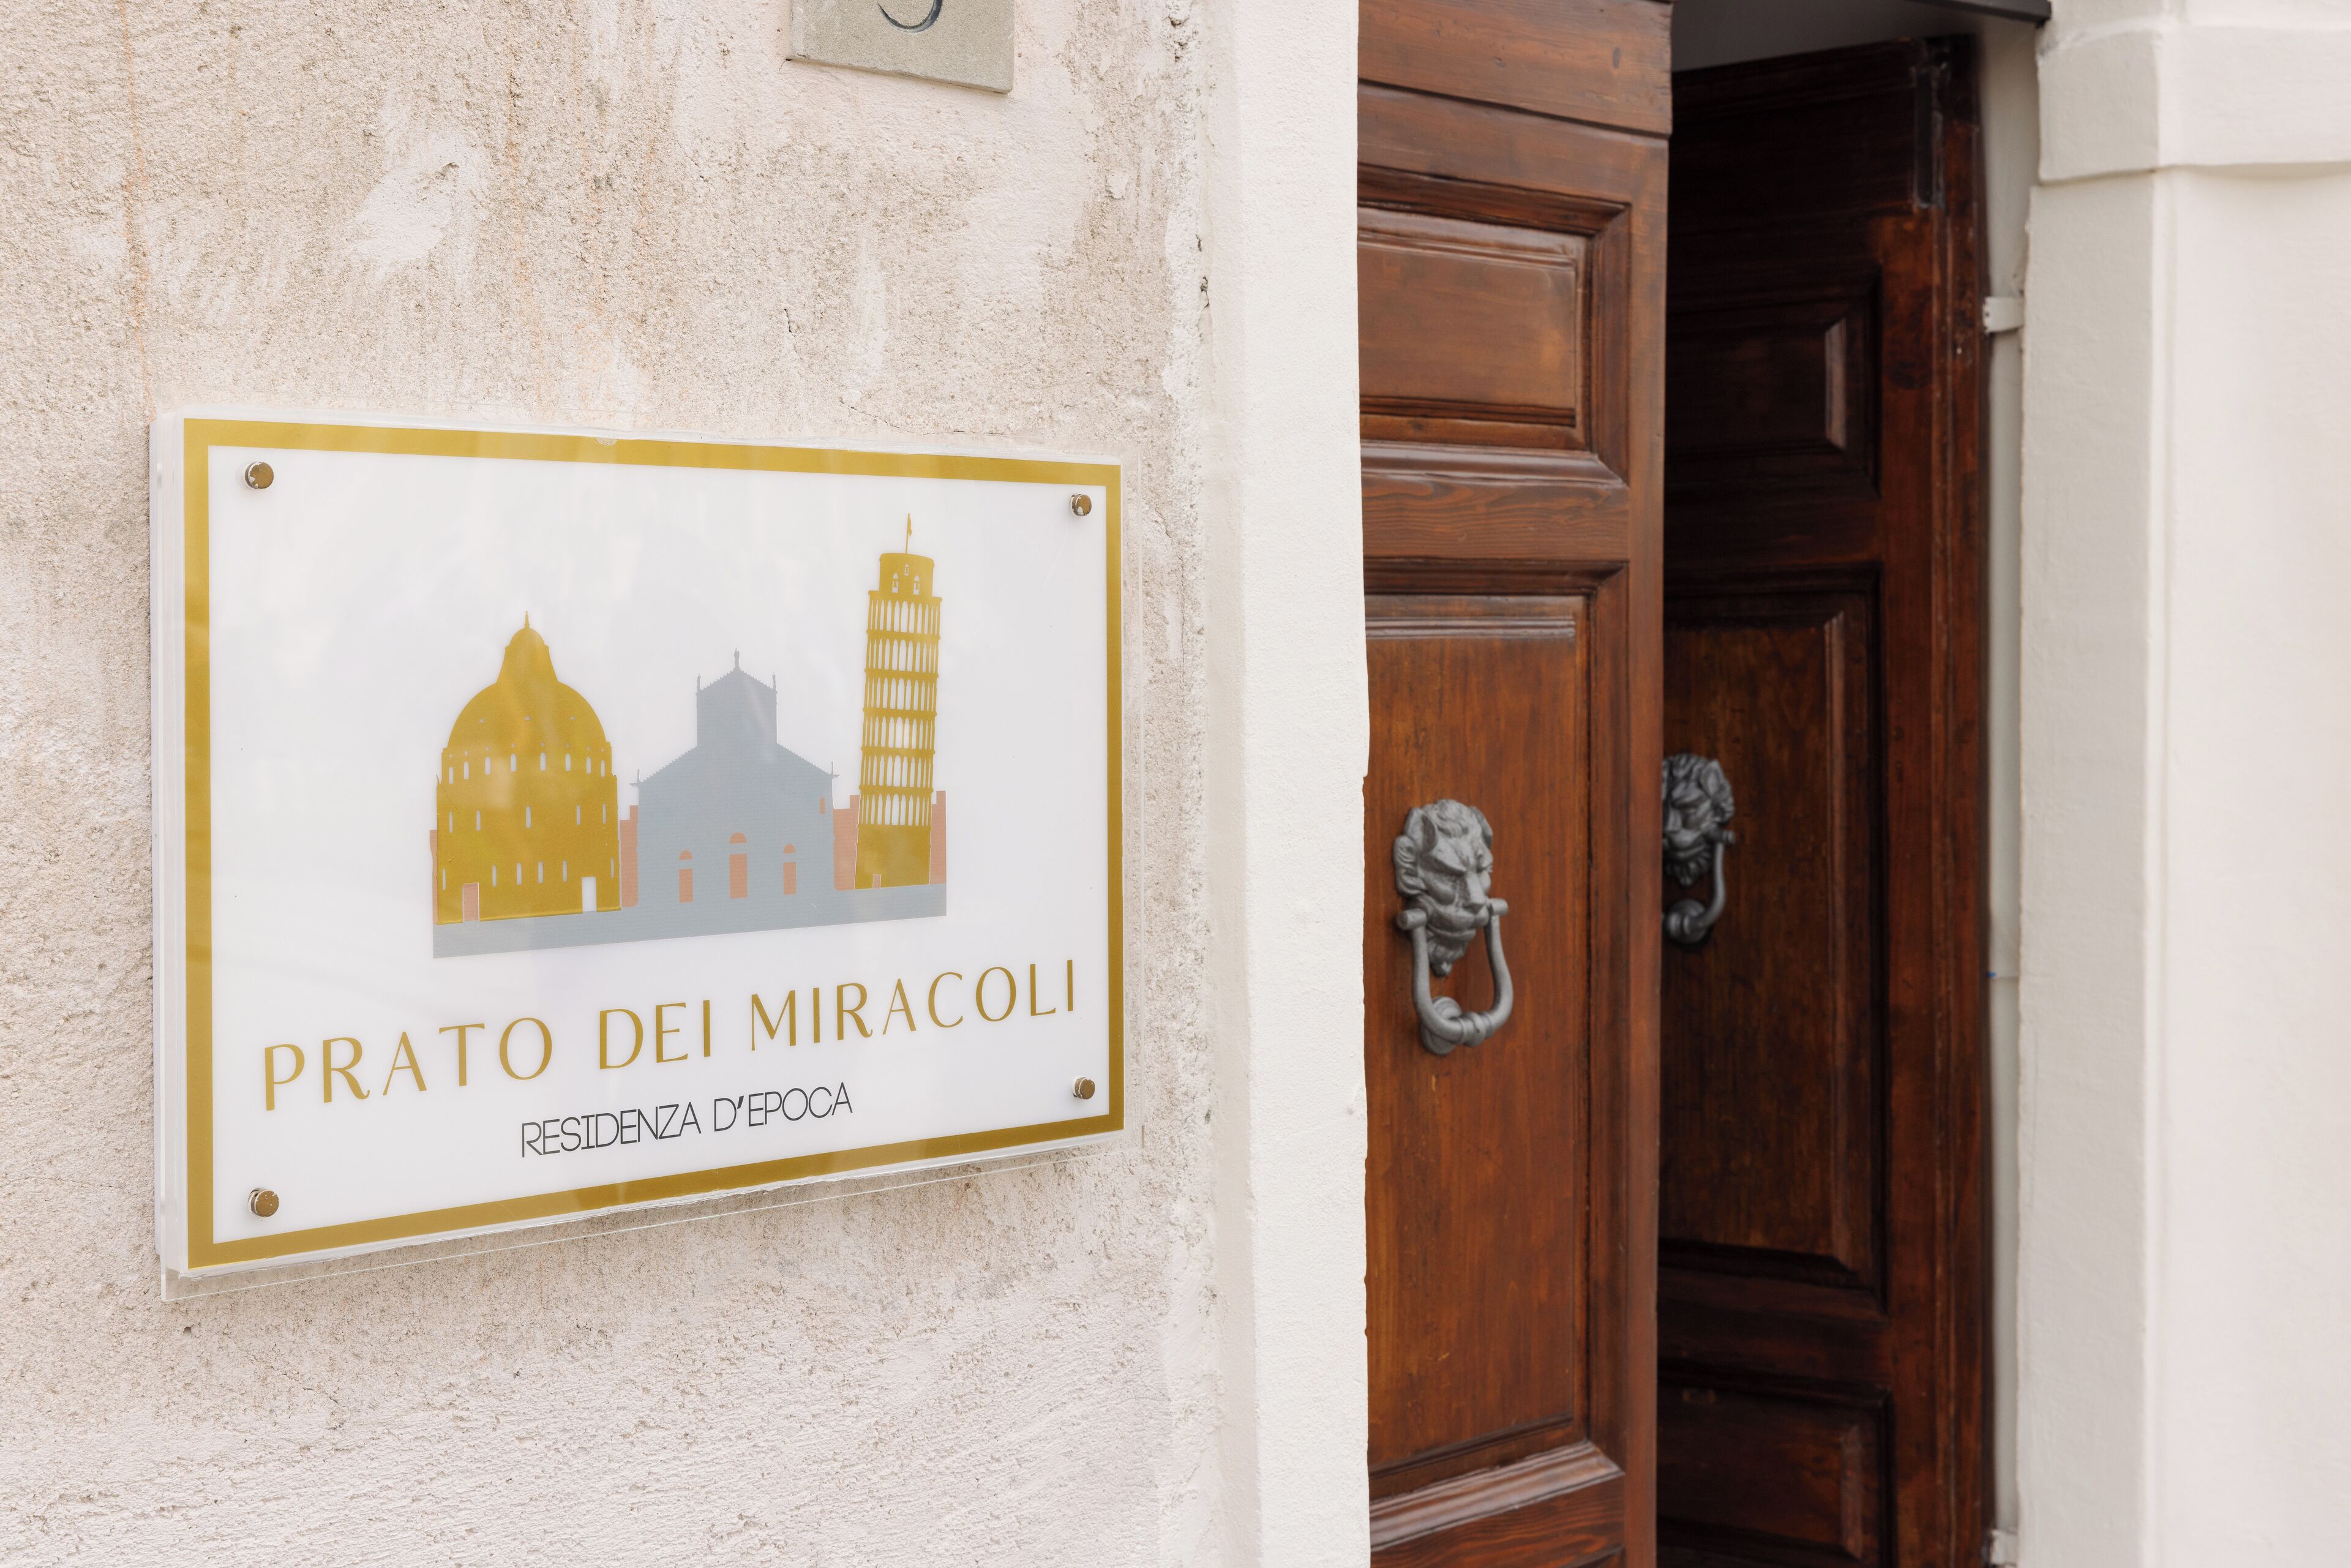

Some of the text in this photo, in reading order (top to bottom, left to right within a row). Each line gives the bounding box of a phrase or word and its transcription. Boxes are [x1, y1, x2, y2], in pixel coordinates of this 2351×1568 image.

[264, 959, 1073, 1111] PRATO DEI MIRACOLI
[522, 1082, 852, 1158] RESIDENZA D'EPOCA
